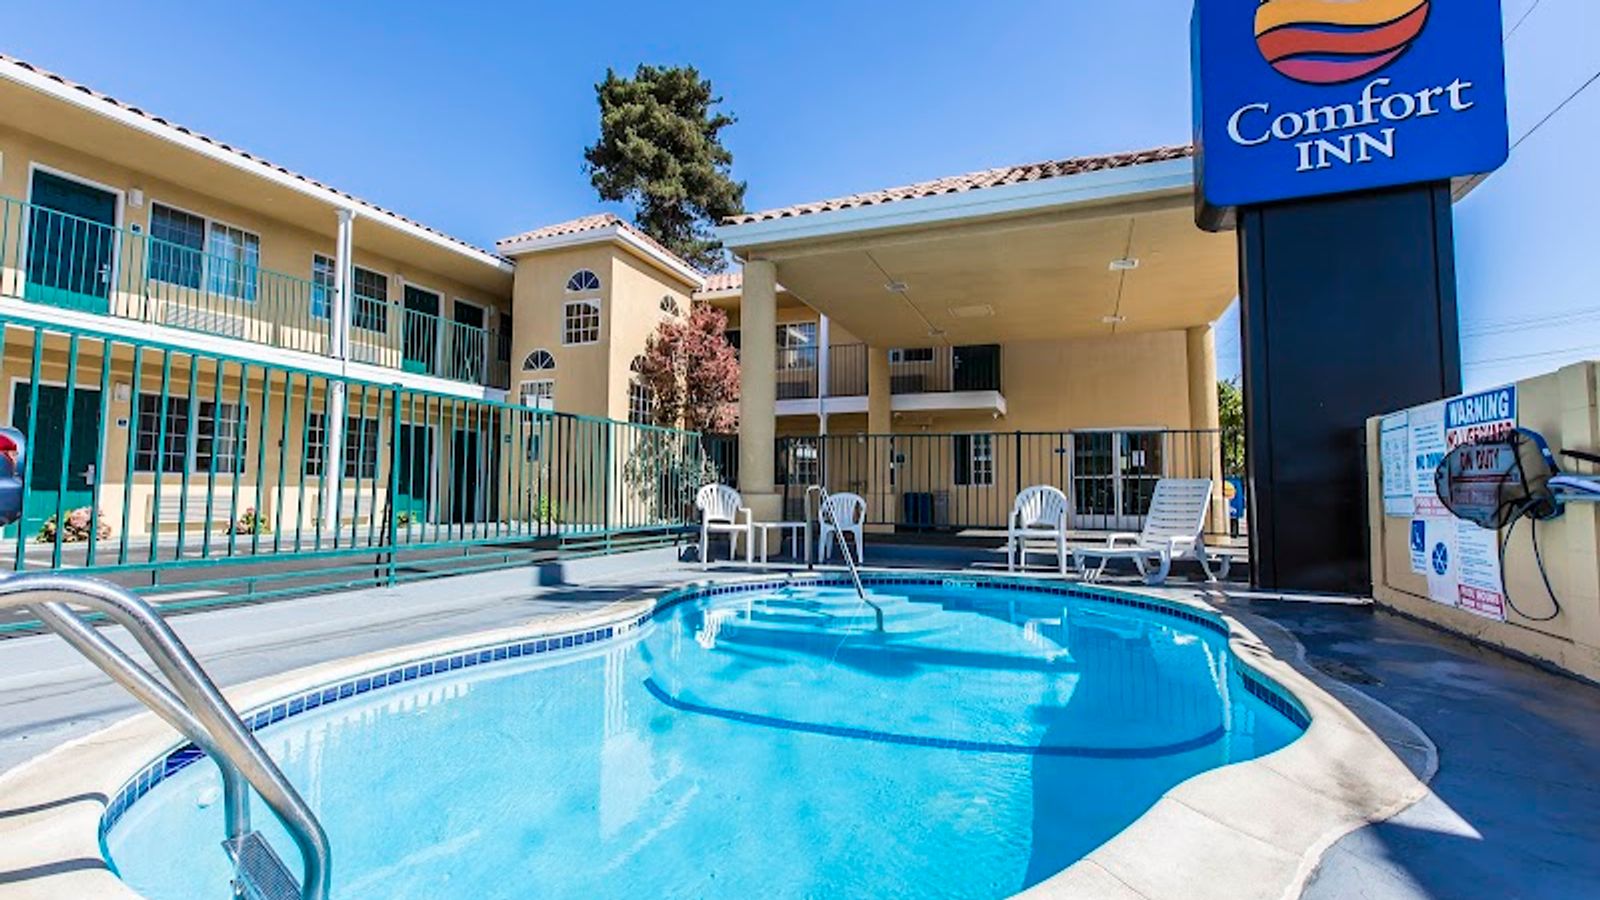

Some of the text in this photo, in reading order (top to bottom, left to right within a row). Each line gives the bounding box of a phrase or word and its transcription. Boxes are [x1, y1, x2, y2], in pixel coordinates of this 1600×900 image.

[1227, 78, 1474, 146] Comfort
[1294, 128, 1395, 172] INN
[1448, 390, 1510, 427] WARNING
[1461, 448, 1500, 471] ON DUTY
